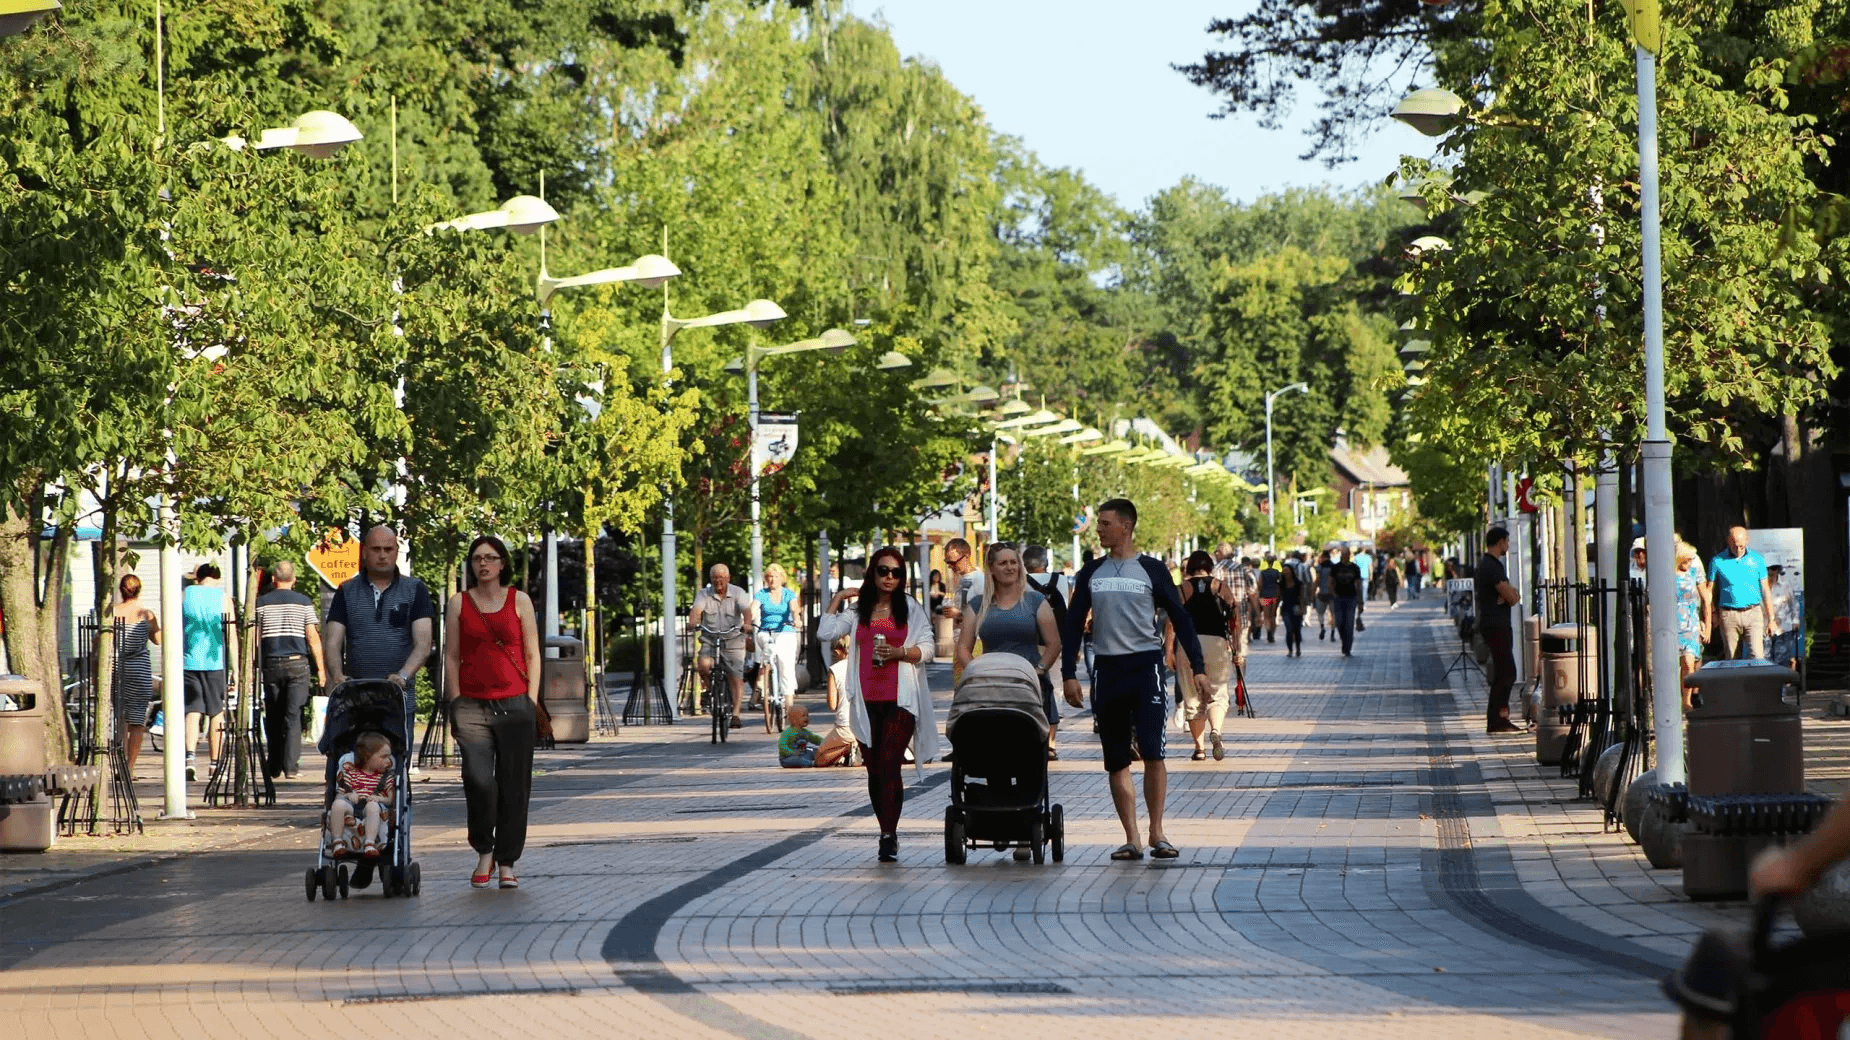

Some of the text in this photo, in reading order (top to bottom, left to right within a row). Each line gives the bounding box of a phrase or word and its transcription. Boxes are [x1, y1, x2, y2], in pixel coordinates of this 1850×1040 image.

[320, 560, 357, 569] coffee
[331, 569, 347, 578] inn
[1448, 580, 1472, 589] FOTO
